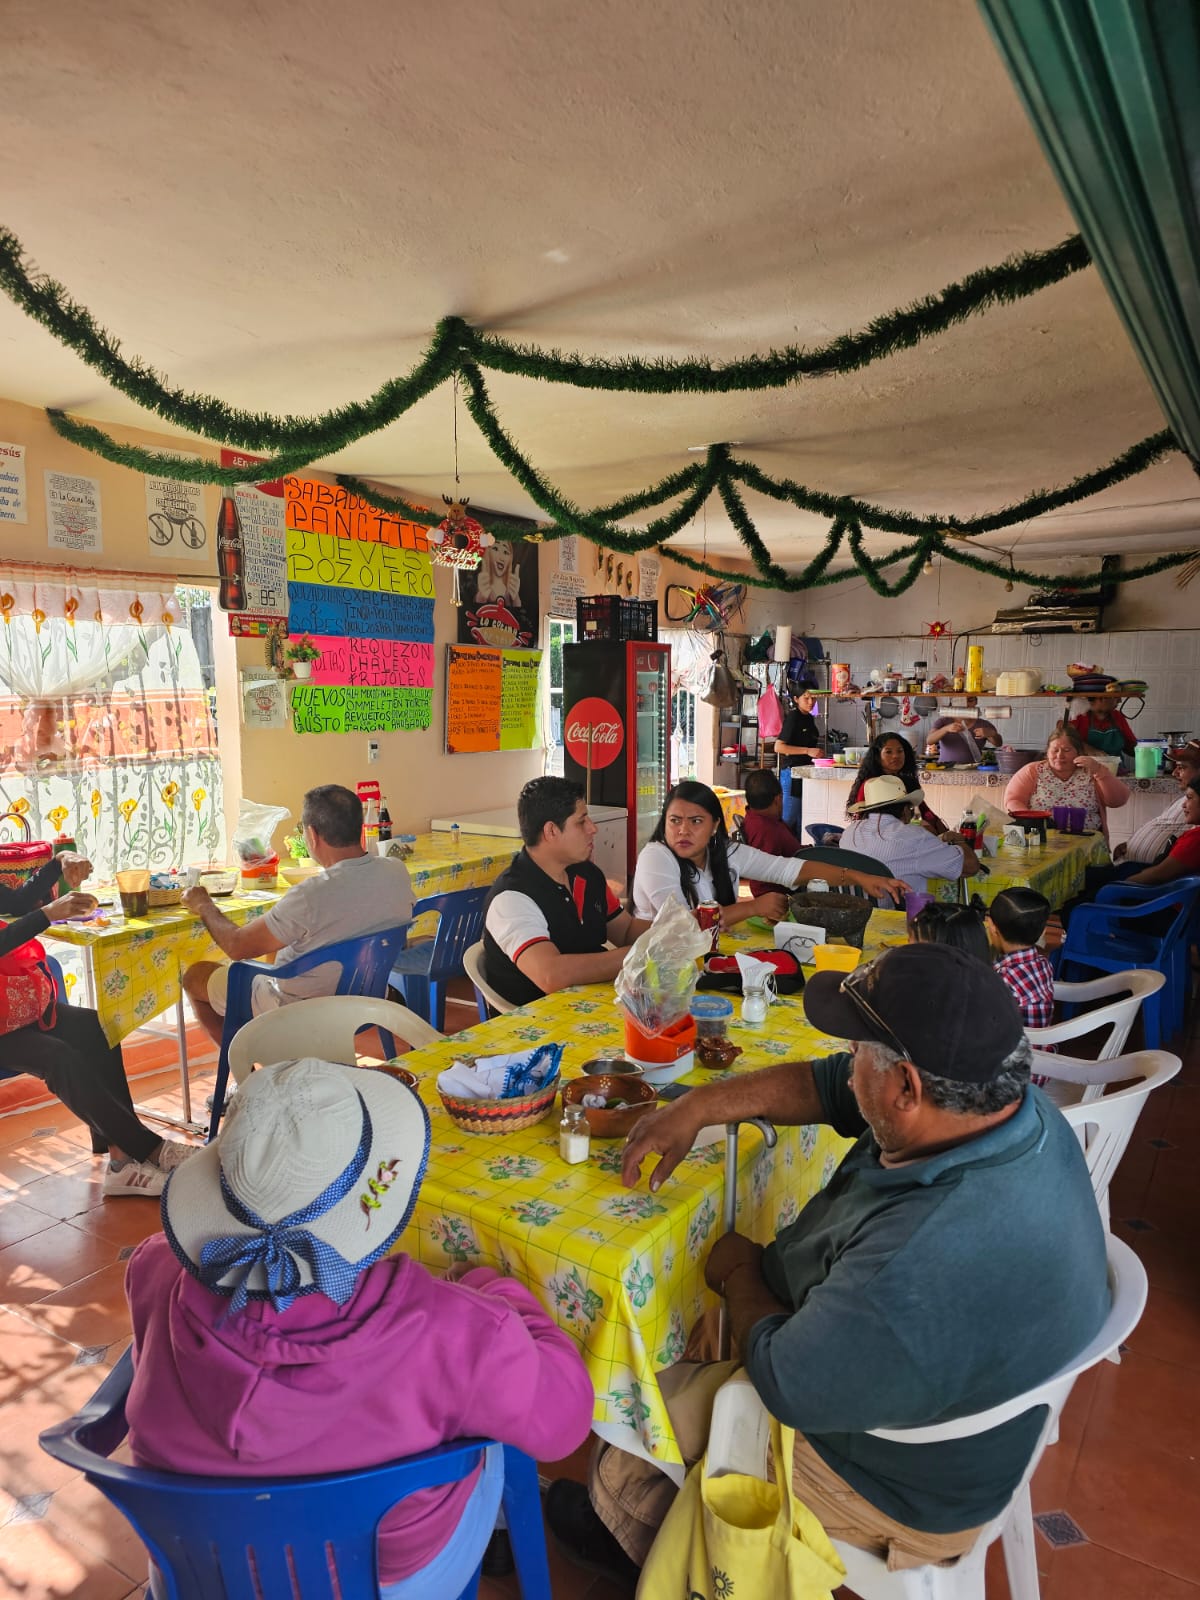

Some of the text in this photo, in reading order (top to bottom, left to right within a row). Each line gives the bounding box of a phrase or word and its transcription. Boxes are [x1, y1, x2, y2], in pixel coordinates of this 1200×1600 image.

[0, 446, 20, 458] esús
[287, 500, 429, 553] PANCITA
[288, 528, 423, 571] JUEVES
[441, 546, 474, 561] Feliz
[430, 553, 481, 570] Navidad
[288, 553, 433, 595] POZOLERO
[349, 637, 430, 661] REQUEZON
[291, 686, 346, 708] HUEVOS
[307, 706, 321, 717] AL
[293, 714, 341, 734] GUSTO
